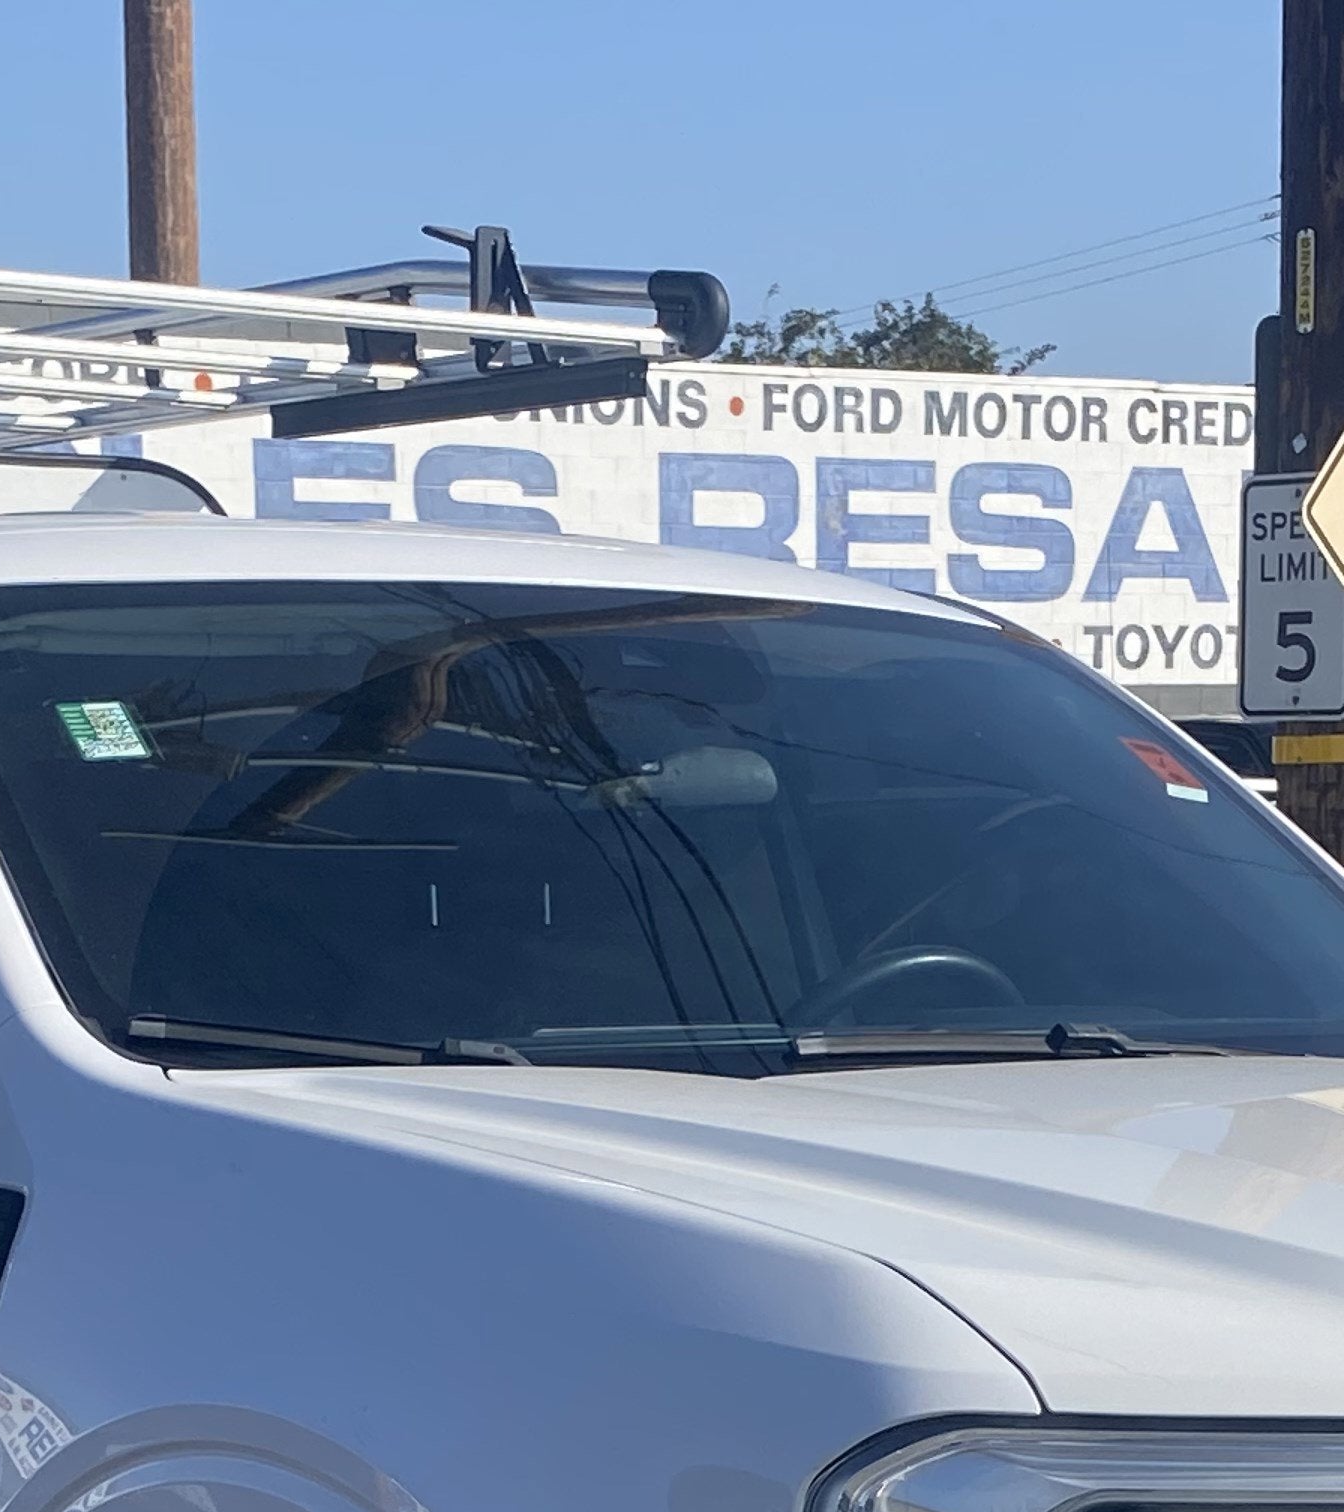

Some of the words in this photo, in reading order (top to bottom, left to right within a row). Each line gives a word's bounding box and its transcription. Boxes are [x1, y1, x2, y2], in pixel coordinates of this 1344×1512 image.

[762, 383, 903, 434] FORD
[923, 390, 1108, 443] MOTOR
[1127, 398, 1254, 447] CRED
[659, 451, 1254, 603] RESA
[1252, 511, 1311, 541] SPE
[1260, 551, 1332, 582] LIMIT
[1083, 623, 1239, 671] TOYO
[1276, 610, 1317, 683] 5
